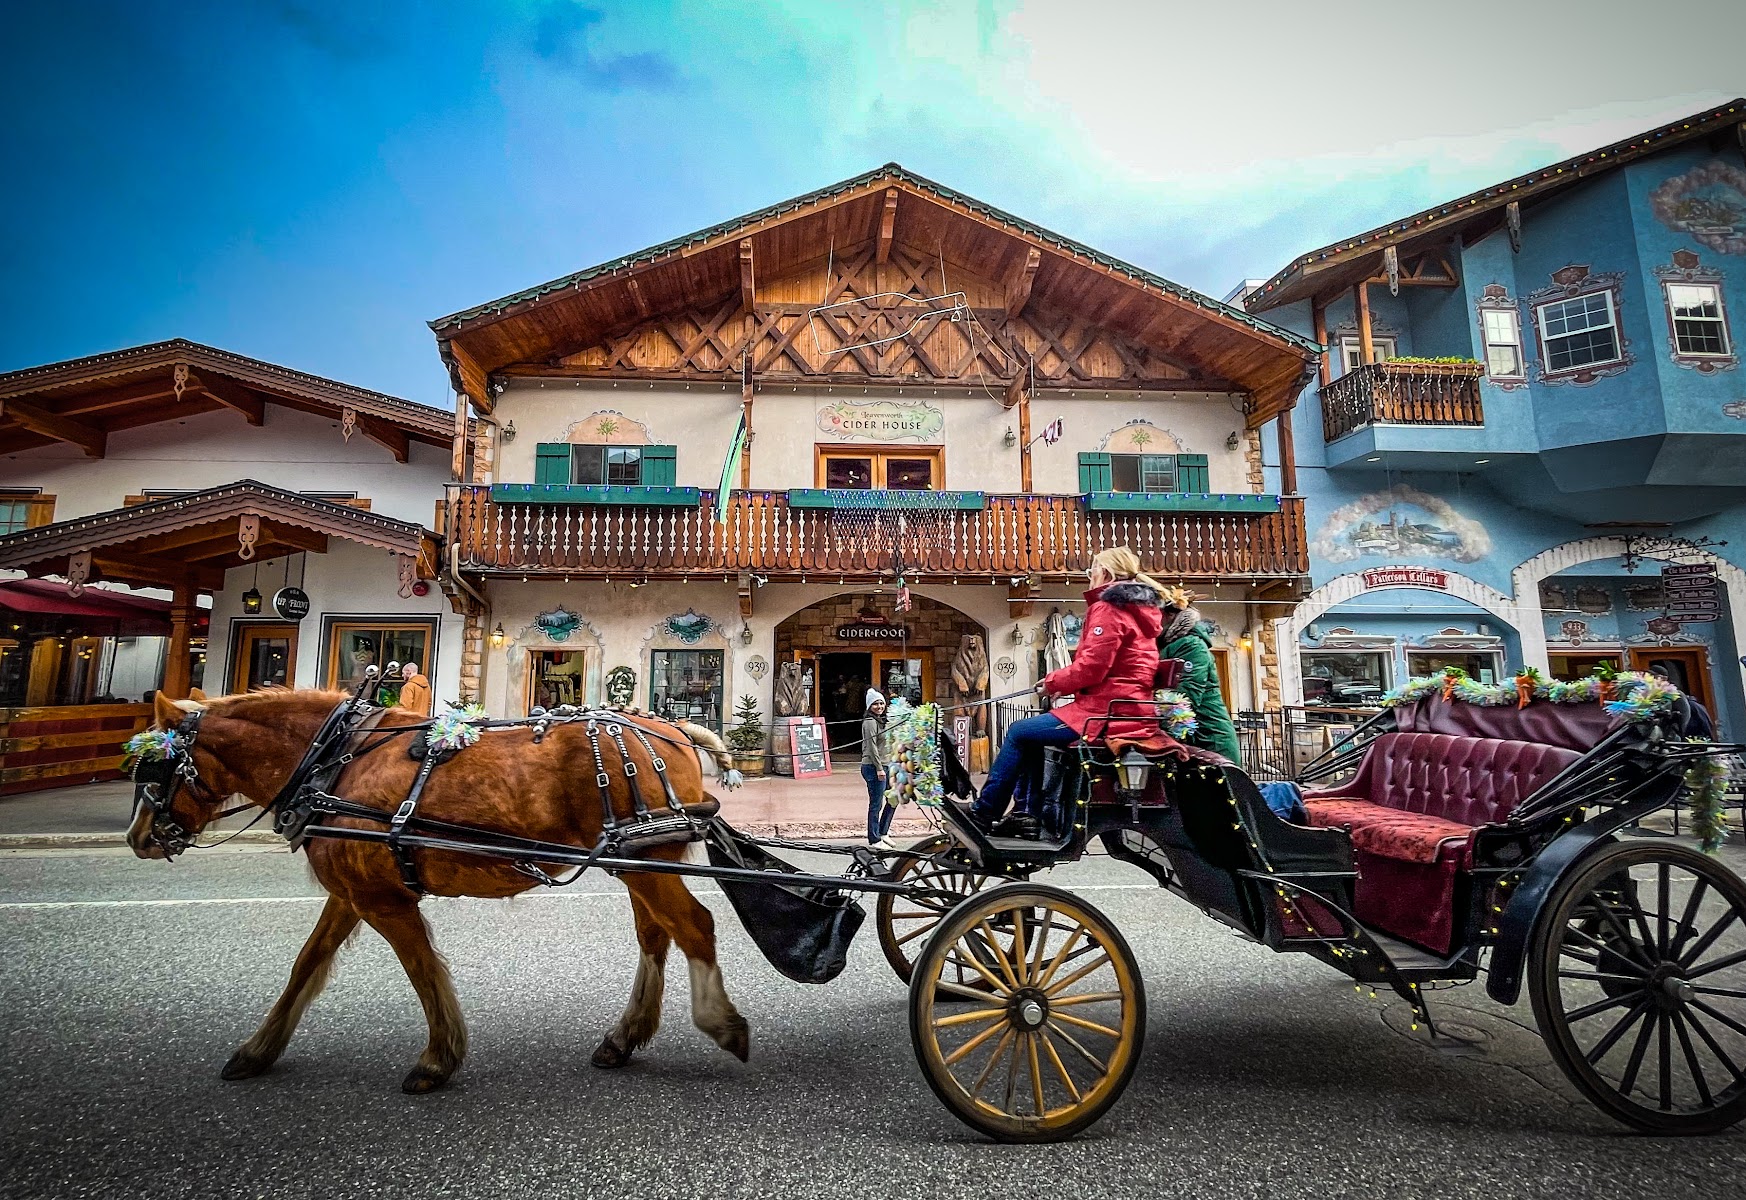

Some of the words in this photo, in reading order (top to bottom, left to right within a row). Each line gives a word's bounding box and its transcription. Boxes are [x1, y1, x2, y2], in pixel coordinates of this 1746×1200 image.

[861, 411, 903, 420] Leavenworth
[843, 420, 877, 430] CIDER
[882, 421, 922, 430] HOUSE
[1371, 573, 1407, 585] Patterson
[1409, 572, 1438, 584] Cellars
[289, 599, 308, 609] FRONT
[748, 661, 766, 673] 939
[997, 662, 1015, 674] 939
